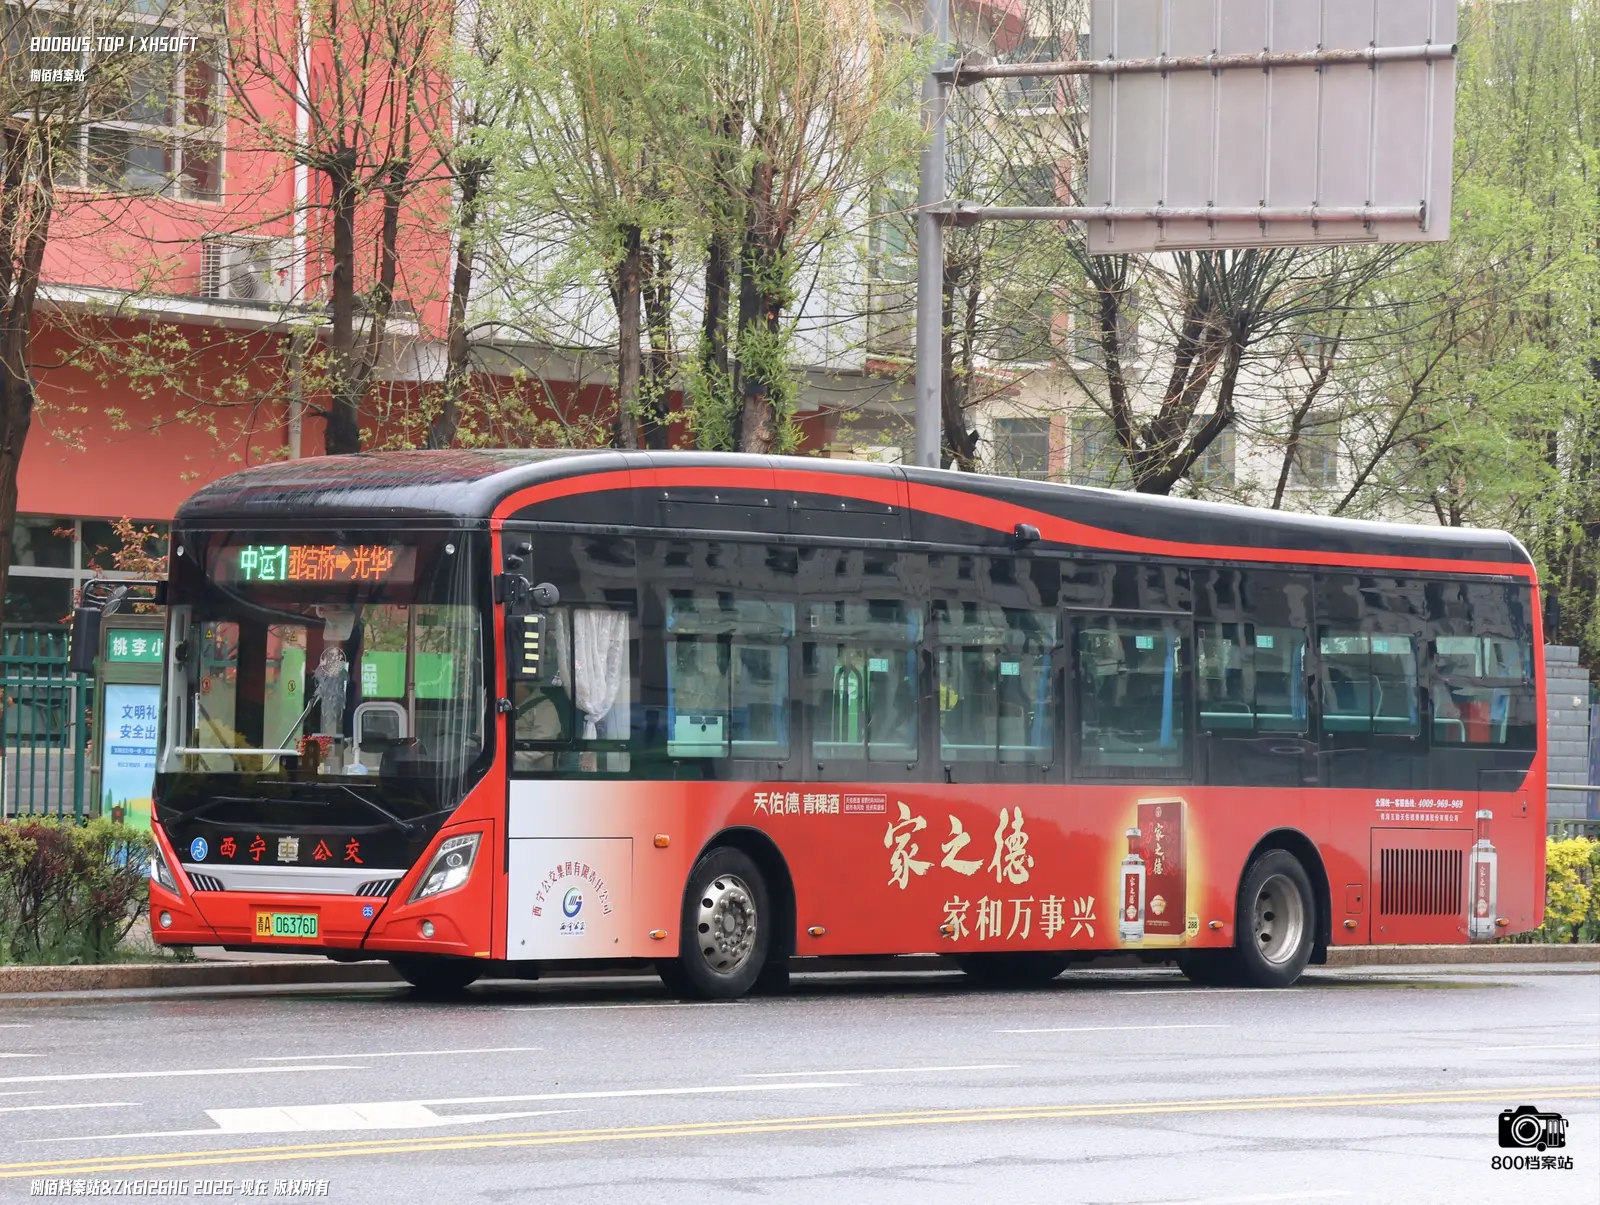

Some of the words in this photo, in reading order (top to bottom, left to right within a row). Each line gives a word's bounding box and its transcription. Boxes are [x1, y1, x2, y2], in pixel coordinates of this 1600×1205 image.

[241, 545, 287, 580] 中运1
[350, 545, 393, 580] 光华
[121, 704, 157, 720] 文明礼
[120, 724, 156, 740] 安全出
[752, 791, 800, 817] 天佑德
[803, 793, 840, 815] 青稞酒
[219, 835, 266, 862] 西宁
[312, 837, 364, 864] 公交
[884, 801, 1034, 890] 家之德
[941, 895, 1097, 942] 家和万事兴
[1187, 920, 1198, 929] 288
